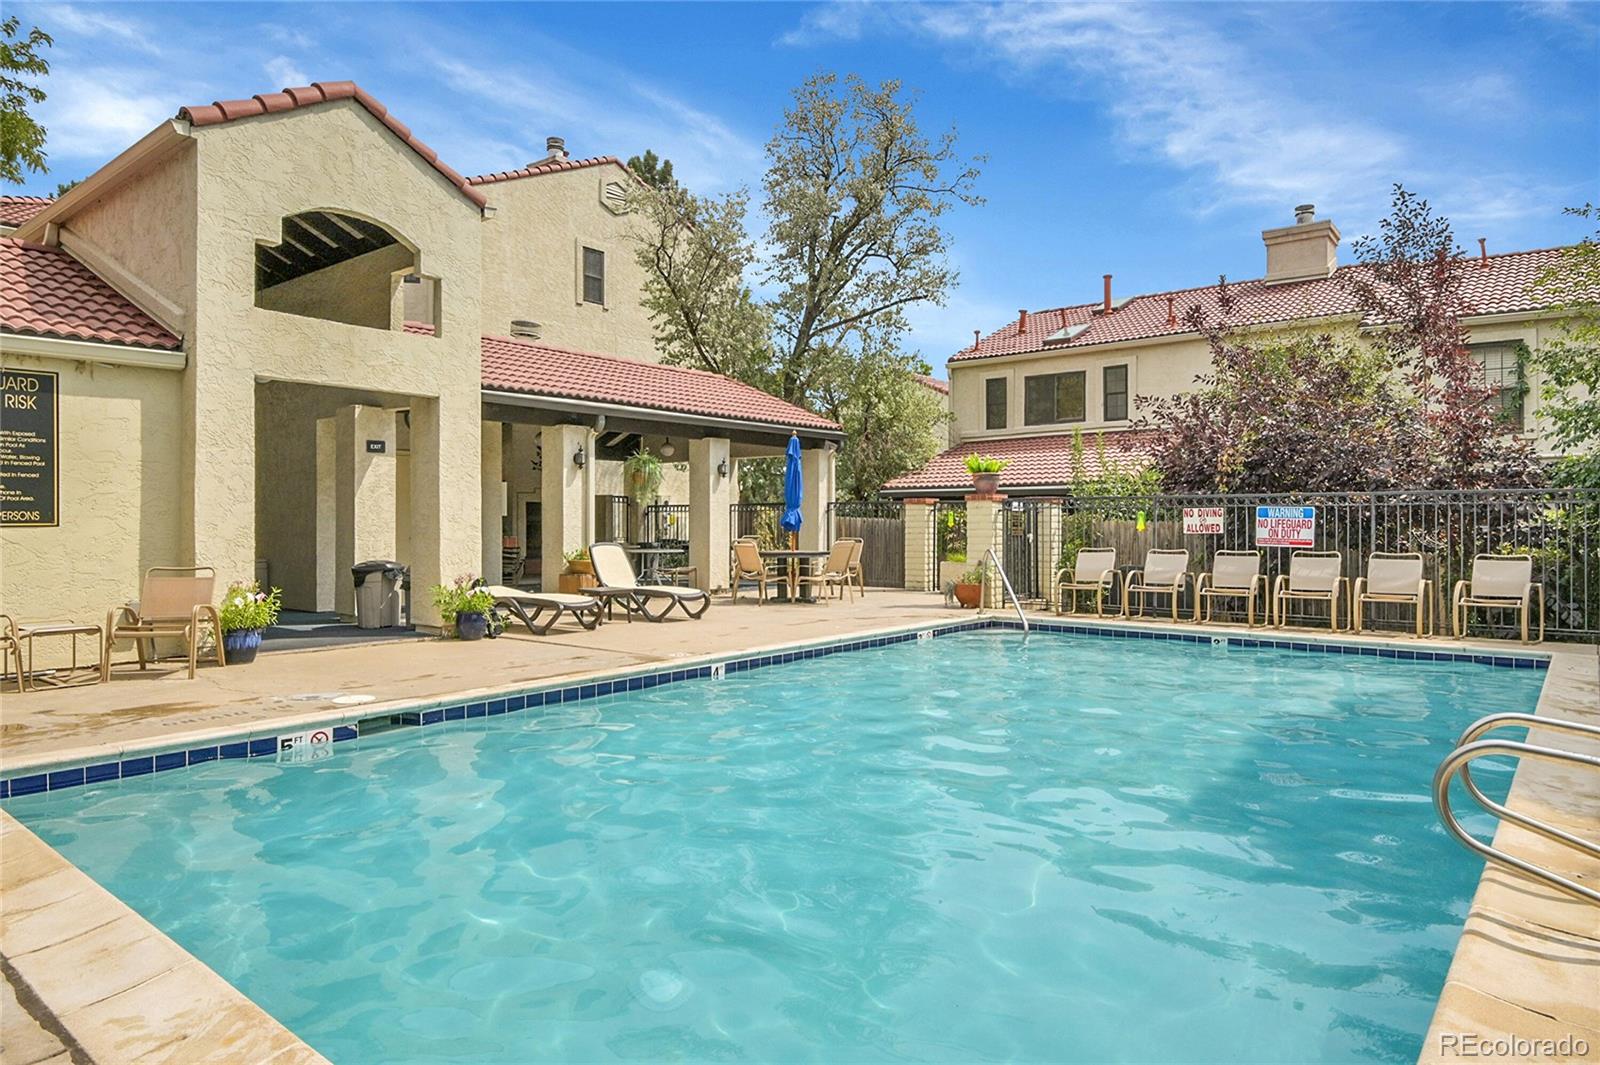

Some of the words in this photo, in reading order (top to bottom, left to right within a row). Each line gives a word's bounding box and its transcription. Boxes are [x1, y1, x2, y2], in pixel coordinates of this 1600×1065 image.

[4, 394, 37, 410] RISK
[18, 471, 40, 479] Fenced
[0, 510, 40, 521] ERSONS
[1183, 508, 1195, 518] NO
[1198, 508, 1223, 518] DIVING
[1267, 507, 1304, 518] WARNING
[1186, 523, 1221, 533] ALLOWED
[1257, 519, 1269, 530] NO
[1270, 519, 1313, 531] LIFEGUARD
[1268, 528, 1280, 539] ON
[1281, 528, 1302, 539] DUTY
[280, 738, 293, 752] 5
[294, 735, 303, 744] FT
